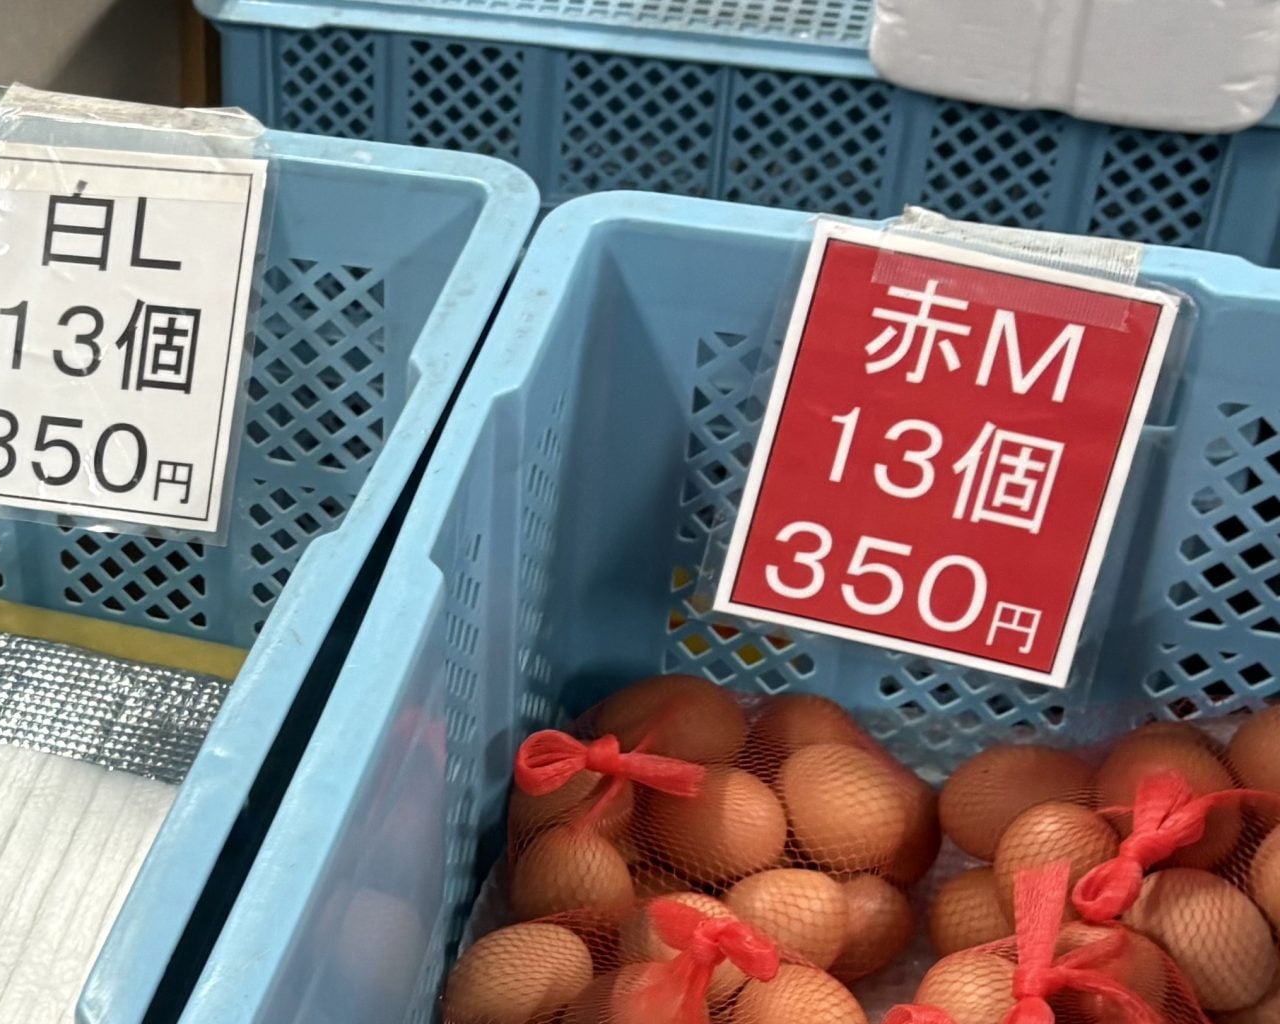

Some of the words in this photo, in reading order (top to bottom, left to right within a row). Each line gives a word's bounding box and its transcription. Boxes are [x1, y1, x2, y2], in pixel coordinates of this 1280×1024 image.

[42, 180, 182, 271] 白L
[0, 299, 202, 394] 13個
[864, 279, 1086, 403] 赤M
[829, 406, 1065, 534] 13個
[765, 521, 1042, 654] 350円
